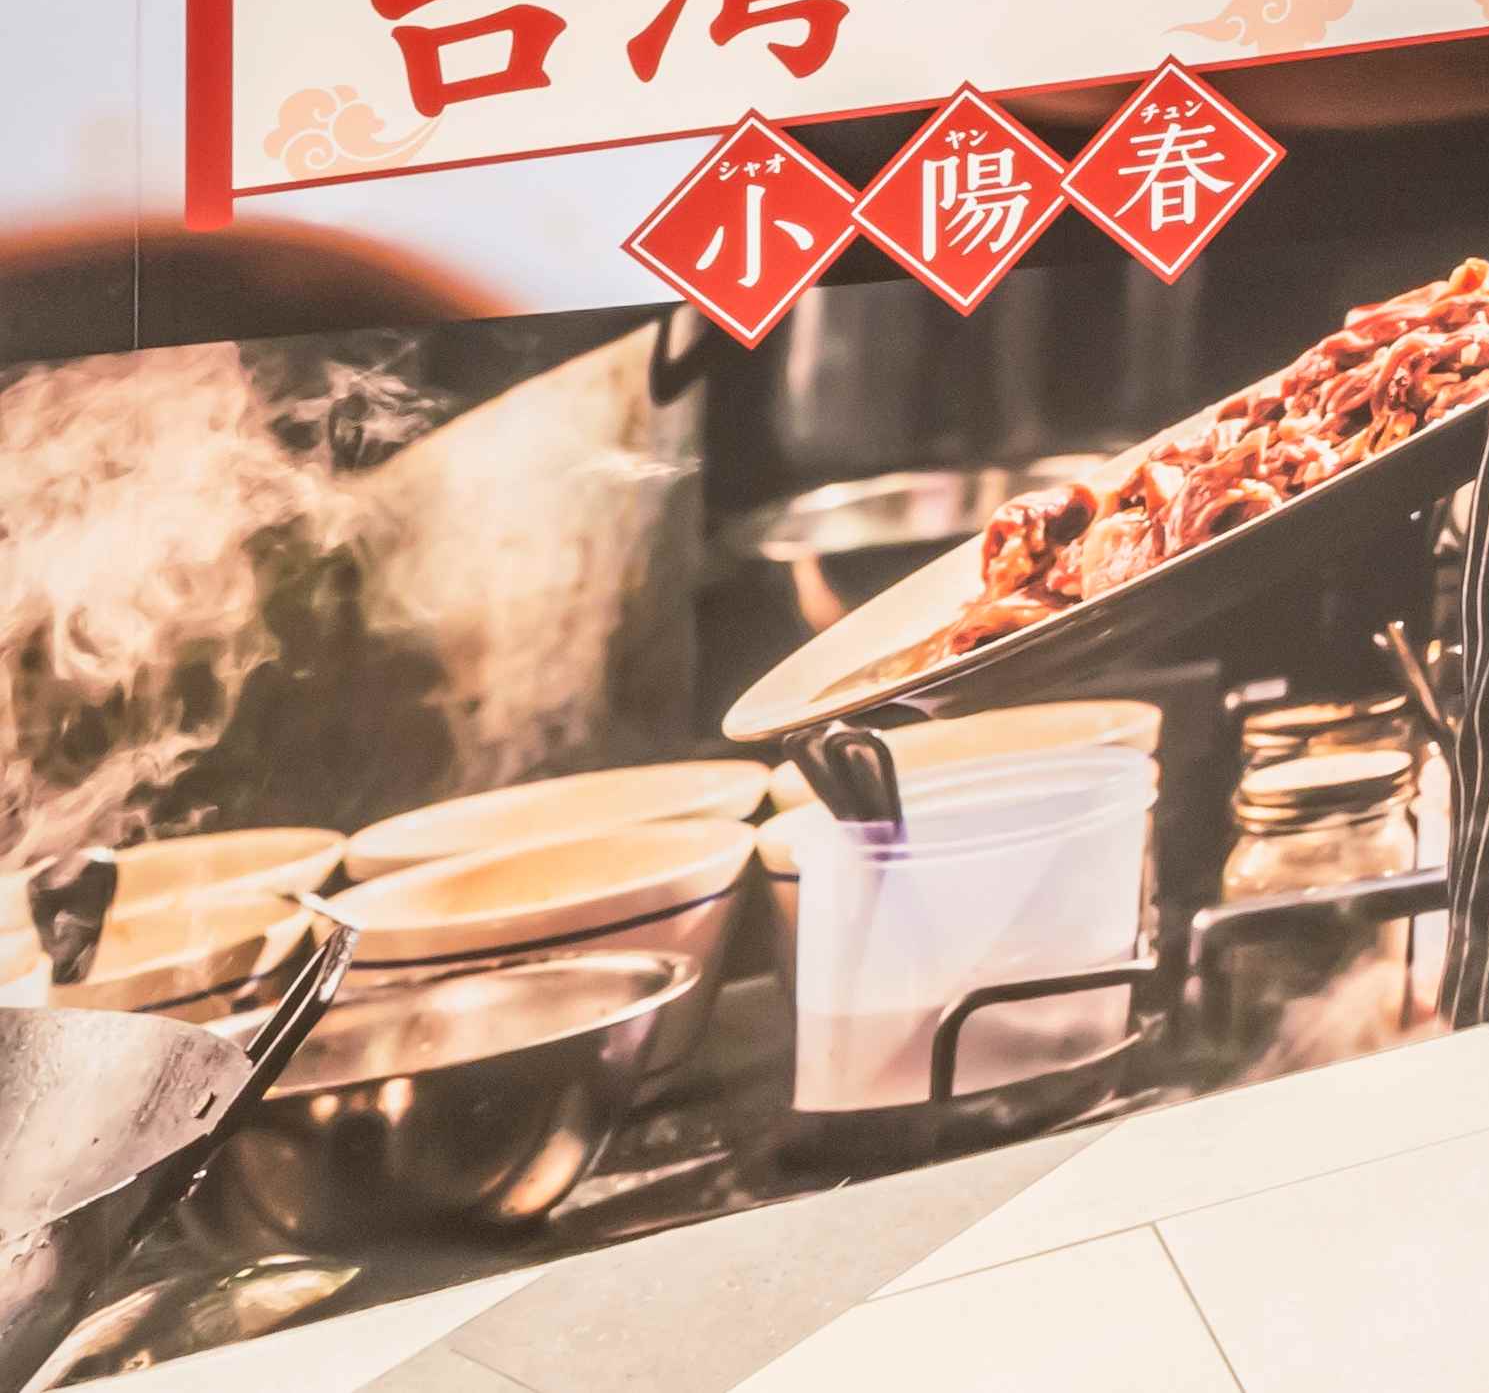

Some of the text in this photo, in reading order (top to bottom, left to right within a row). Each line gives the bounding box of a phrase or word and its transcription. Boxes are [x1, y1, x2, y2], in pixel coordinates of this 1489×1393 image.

[718, 99, 1204, 181] シャオ ヤン チュン
